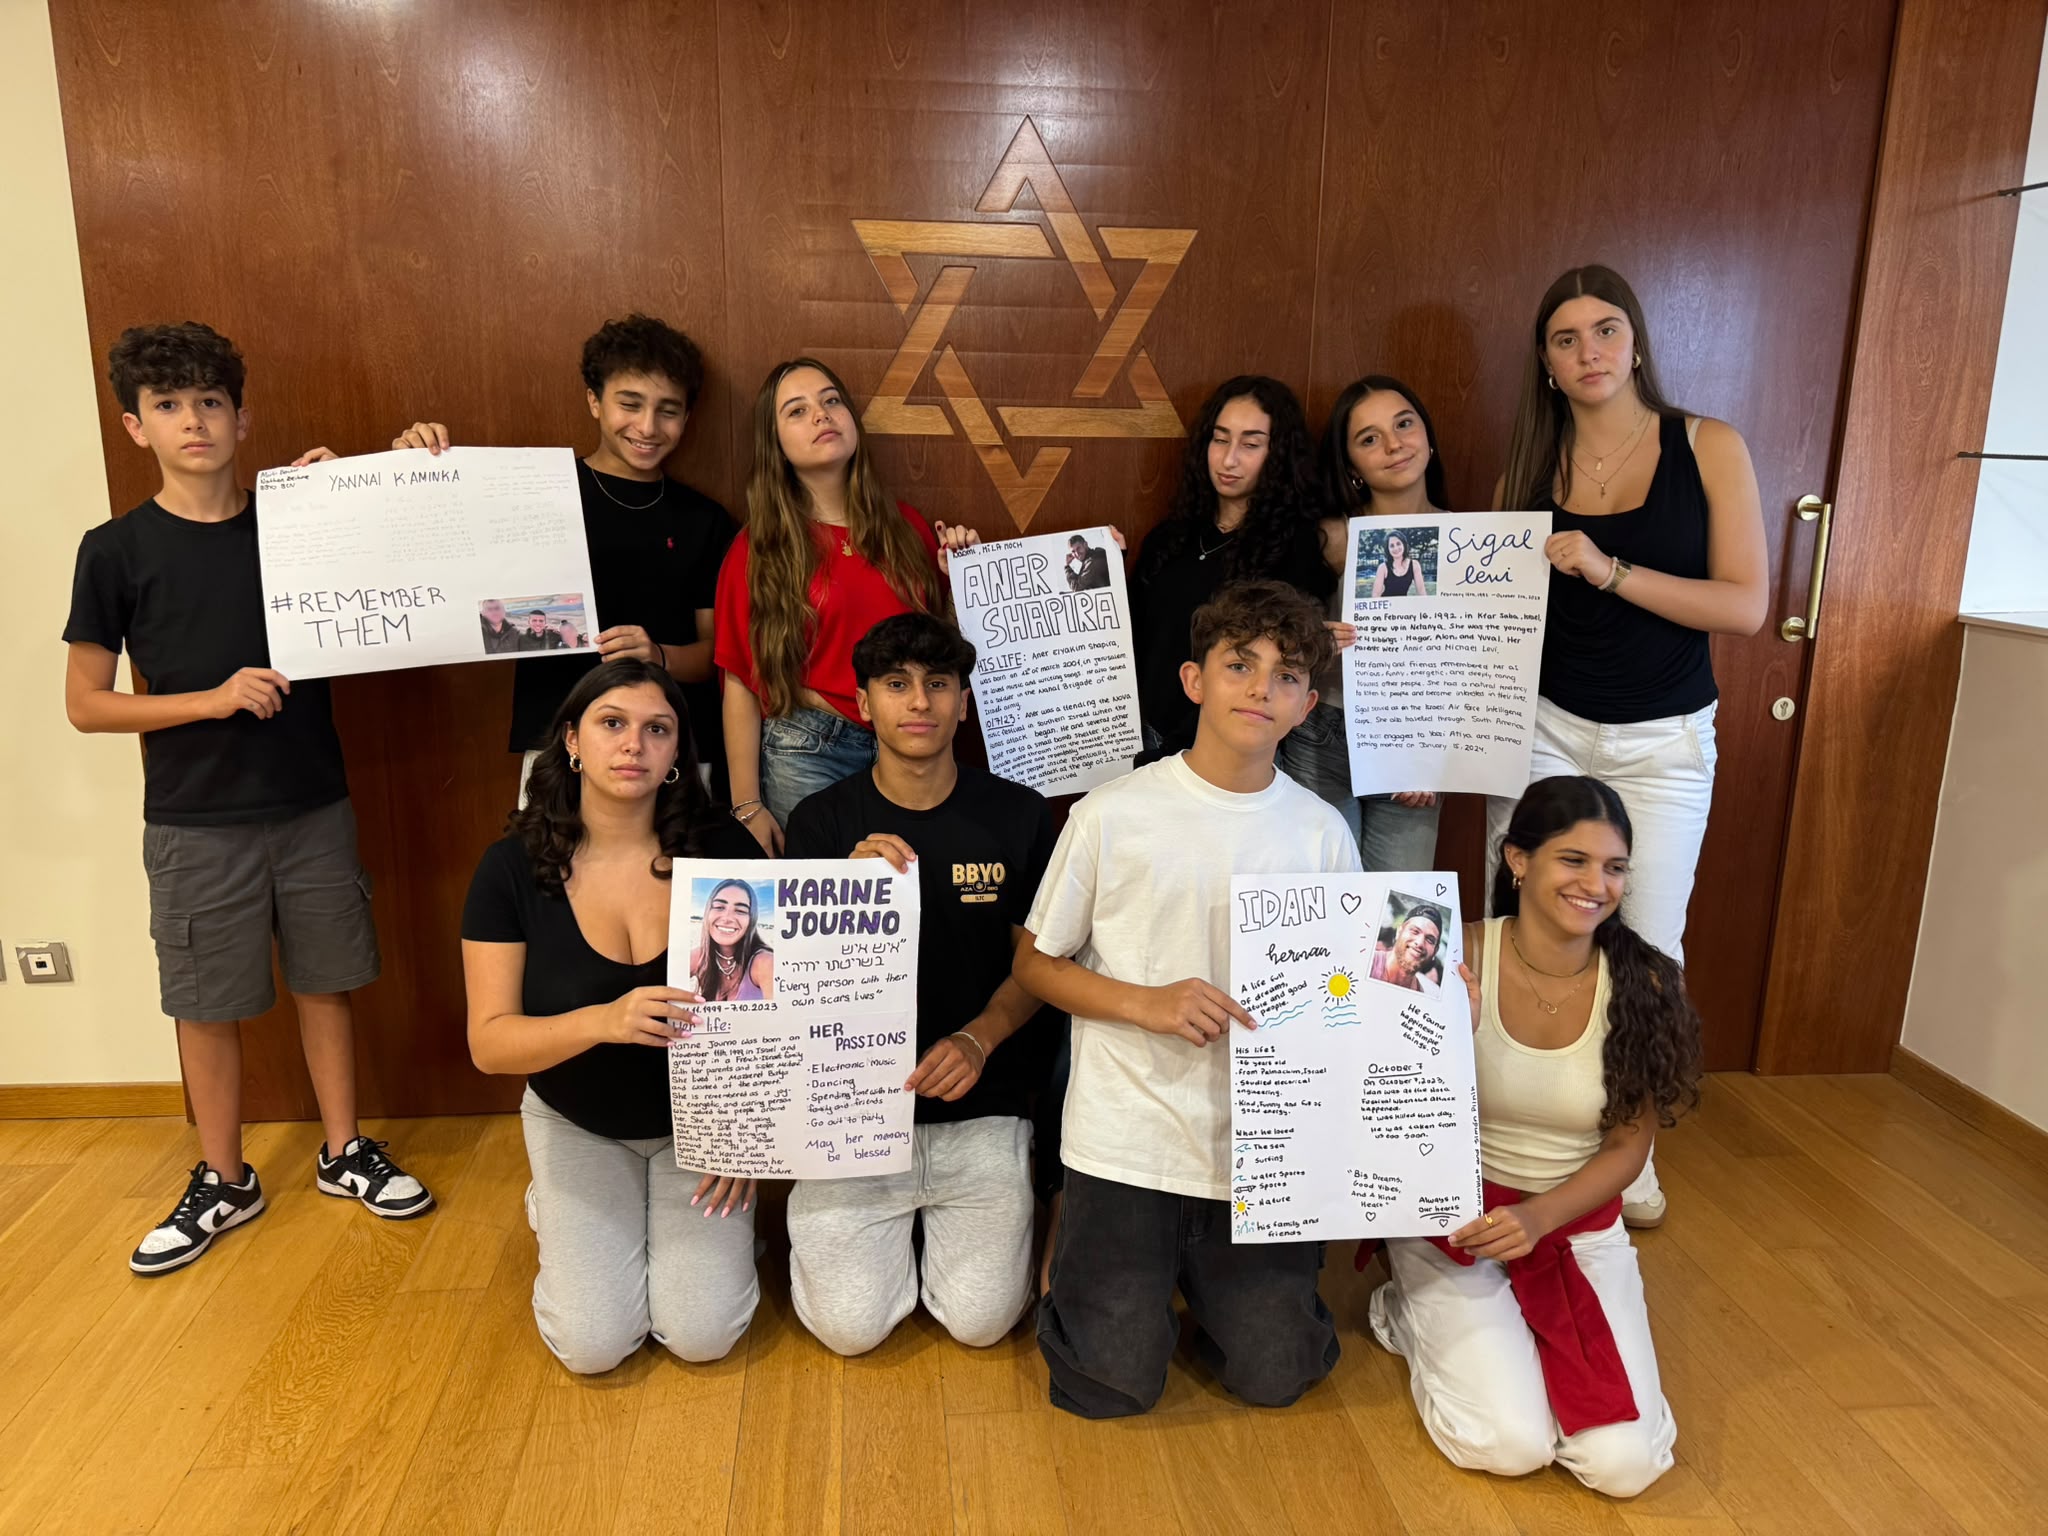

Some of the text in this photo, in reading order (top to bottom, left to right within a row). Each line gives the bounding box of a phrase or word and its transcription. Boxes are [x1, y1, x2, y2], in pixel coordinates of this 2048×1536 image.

[329, 472, 381, 492] YANNAI
[394, 469, 460, 486] KAMINKA
[1446, 527, 1534, 566] Sigal
[964, 553, 1052, 609] ANER
[270, 586, 446, 613] #REMEMBER
[1354, 602, 1367, 610] HER
[983, 592, 1120, 648] SHAPIRA
[1384, 613, 1417, 622] February
[1477, 612, 1496, 620] Kfar
[303, 613, 412, 648] THEM
[1449, 621, 1465, 630] She
[1485, 622, 1500, 630] the
[1503, 624, 1537, 634] youngest
[1506, 636, 1521, 644] Her
[976, 658, 994, 673] HIS
[996, 652, 1026, 667] LIFE:
[1354, 660, 1367, 668] Her
[1062, 678, 1092, 690] Brigade
[1093, 708, 1113, 717] when
[1112, 713, 1128, 722] other
[952, 863, 1006, 885] BBYO
[778, 877, 893, 907] KARINE
[1239, 886, 1326, 932] IDAN
[780, 910, 900, 940] JOURNO
[842, 943, 868, 955] איש
[817, 979, 854, 992] person
[861, 975, 879, 984] with
[885, 973, 908, 983] their
[1241, 984, 1248, 994] A
[1250, 979, 1268, 990] life
[1270, 980, 1308, 1003] and good
[792, 998, 814, 1007] own
[820, 994, 850, 1004] scars
[1408, 1004, 1446, 1030] He found
[707, 1016, 731, 1032] life:
[810, 1023, 844, 1038] HER
[836, 1031, 906, 1051] PASSIONS
[696, 1059, 706, 1067] up
[812, 1063, 865, 1073] Electronic
[1368, 1063, 1412, 1074] October
[812, 1078, 856, 1089] Dancing
[811, 1092, 852, 1103] Spending
[854, 1097, 883, 1106] friends
[810, 1118, 823, 1127] Go
[828, 1117, 842, 1126] out
[862, 1113, 885, 1124] party
[805, 1131, 910, 1153] May her memory
[771, 1157, 784, 1165] her
[828, 1147, 891, 1162] be blessed
[1353, 1180, 1374, 1189] Good
[1351, 1190, 1367, 1198] And
[1259, 1196, 1291, 1206] Nature
[1257, 1222, 1270, 1231] his
